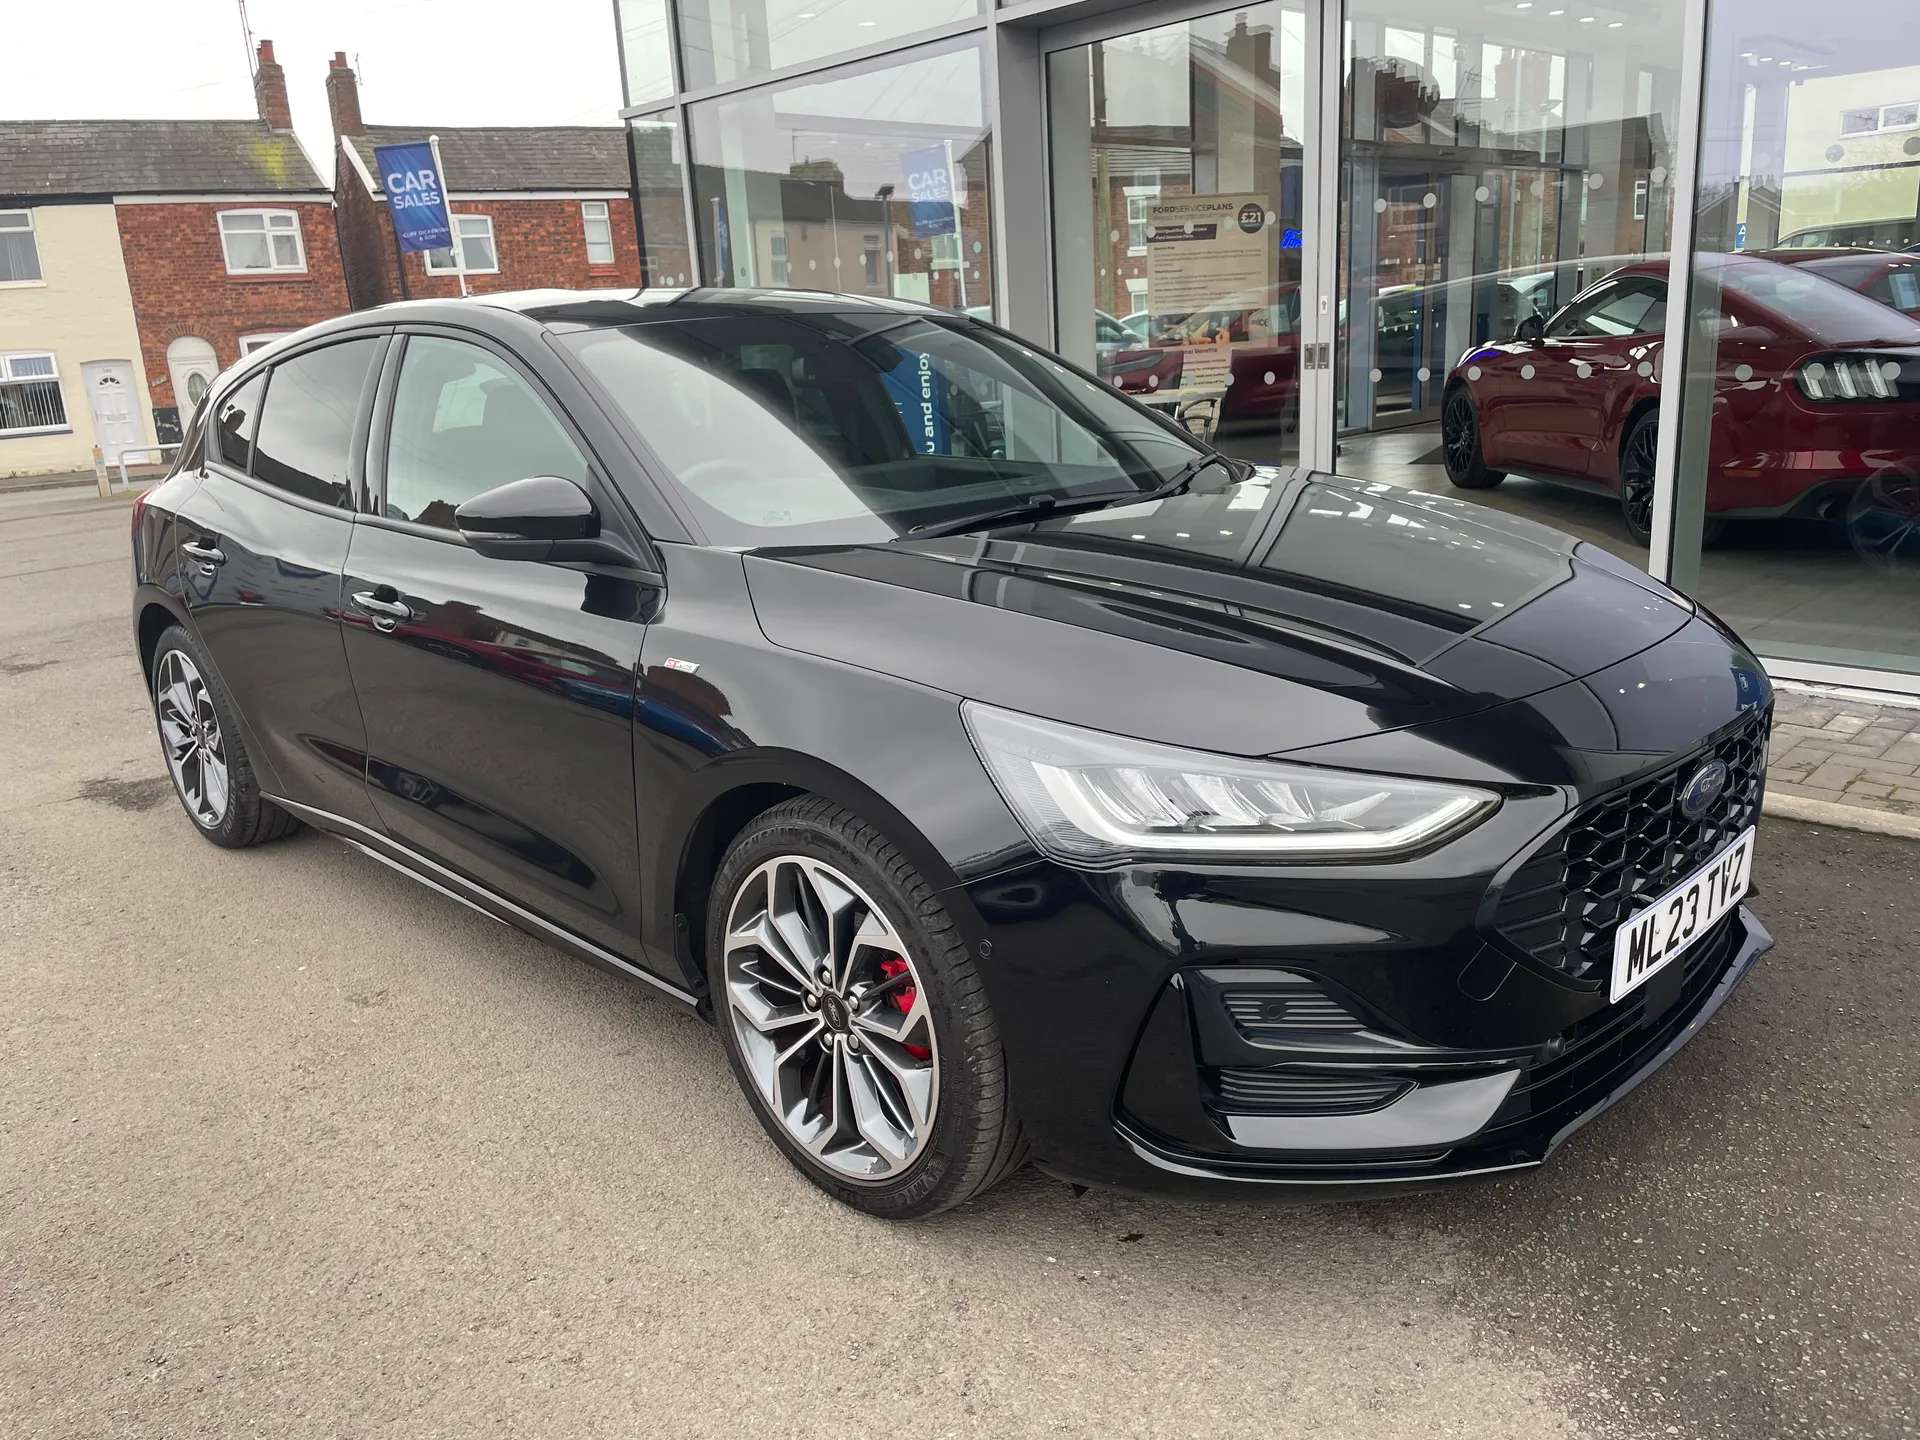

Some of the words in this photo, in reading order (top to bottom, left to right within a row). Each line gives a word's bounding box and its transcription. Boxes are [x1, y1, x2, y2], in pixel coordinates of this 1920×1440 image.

[387, 170, 436, 193] CAR
[908, 168, 947, 189] CAR
[393, 192, 441, 209] SALES
[1240, 212, 1262, 223] £21
[918, 352, 932, 399] enjoy
[920, 402, 935, 437] and
[1626, 883, 1700, 984] ML23
[1707, 842, 1747, 920] TVZ
